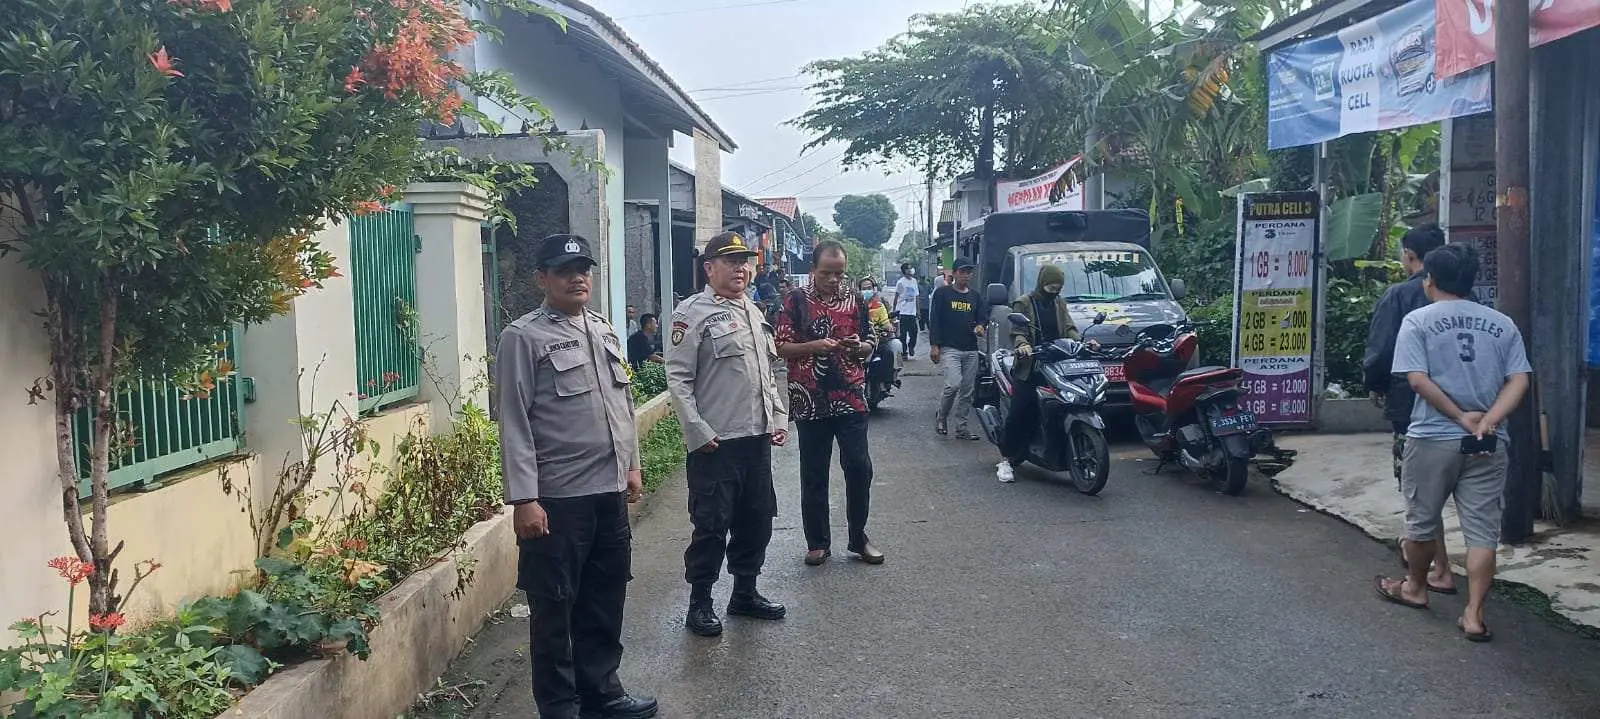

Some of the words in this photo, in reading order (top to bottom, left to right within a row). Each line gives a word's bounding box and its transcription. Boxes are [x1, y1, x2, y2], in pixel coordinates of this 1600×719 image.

[1341, 63, 1374, 85] KUOTA
[1347, 92, 1371, 110] CELL
[1250, 202, 1280, 216] PUTRA
[1282, 202, 1304, 215] CELL
[1305, 202, 1312, 214] 3
[1250, 251, 1255, 278] 1
[1257, 251, 1269, 278] GB
[1287, 250, 1308, 278] 8.000
[1245, 312, 1251, 329] 2
[1252, 312, 1265, 329] GB
[1244, 334, 1249, 351] 4
[1251, 334, 1265, 351] GB
[1280, 333, 1307, 351] 23.000
[1456, 332, 1475, 362] 3
[1254, 380, 1267, 394] GB
[1282, 379, 1307, 394] 12.000
[1253, 401, 1266, 414] GB
